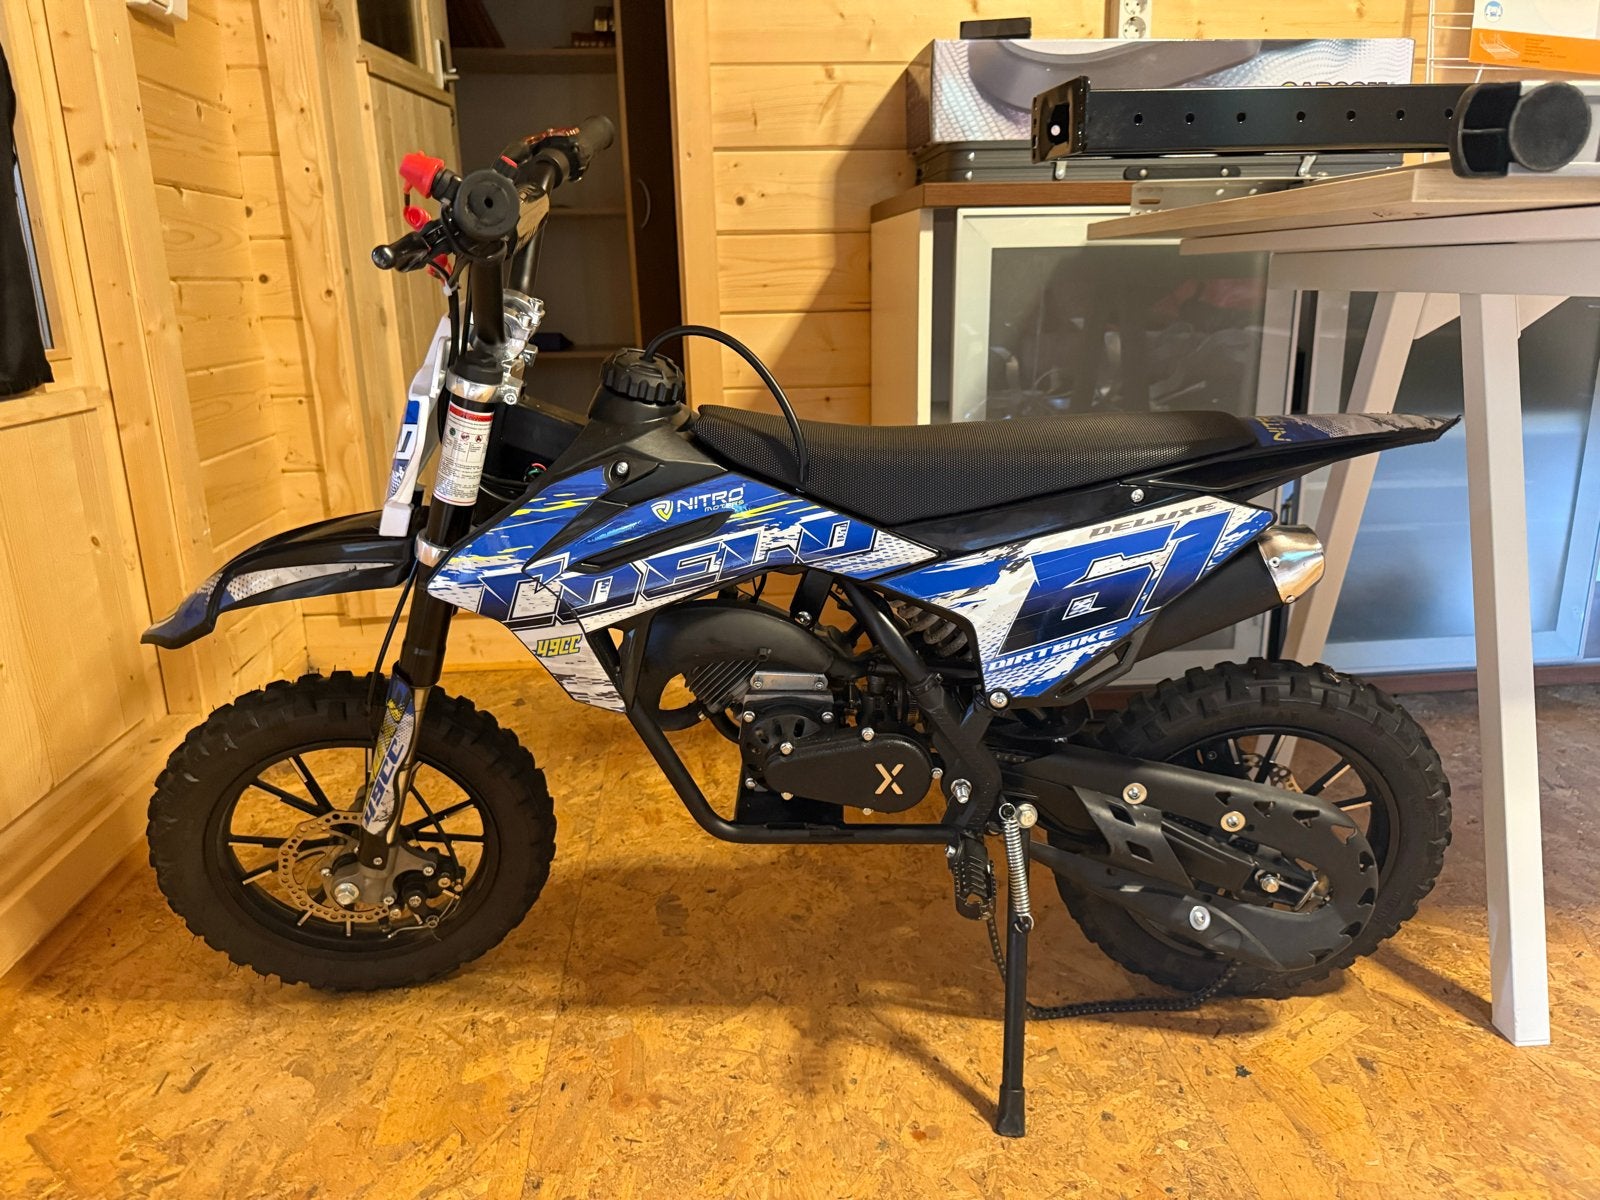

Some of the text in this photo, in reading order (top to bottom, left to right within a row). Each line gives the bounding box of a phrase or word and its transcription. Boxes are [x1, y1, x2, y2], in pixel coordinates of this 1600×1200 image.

[677, 487, 744, 513] NITRO
[1089, 501, 1218, 539] DELUXE
[536, 633, 583, 658] 49CC
[987, 626, 1118, 672] DIRTBIKE
[364, 737, 405, 828] 49CC
